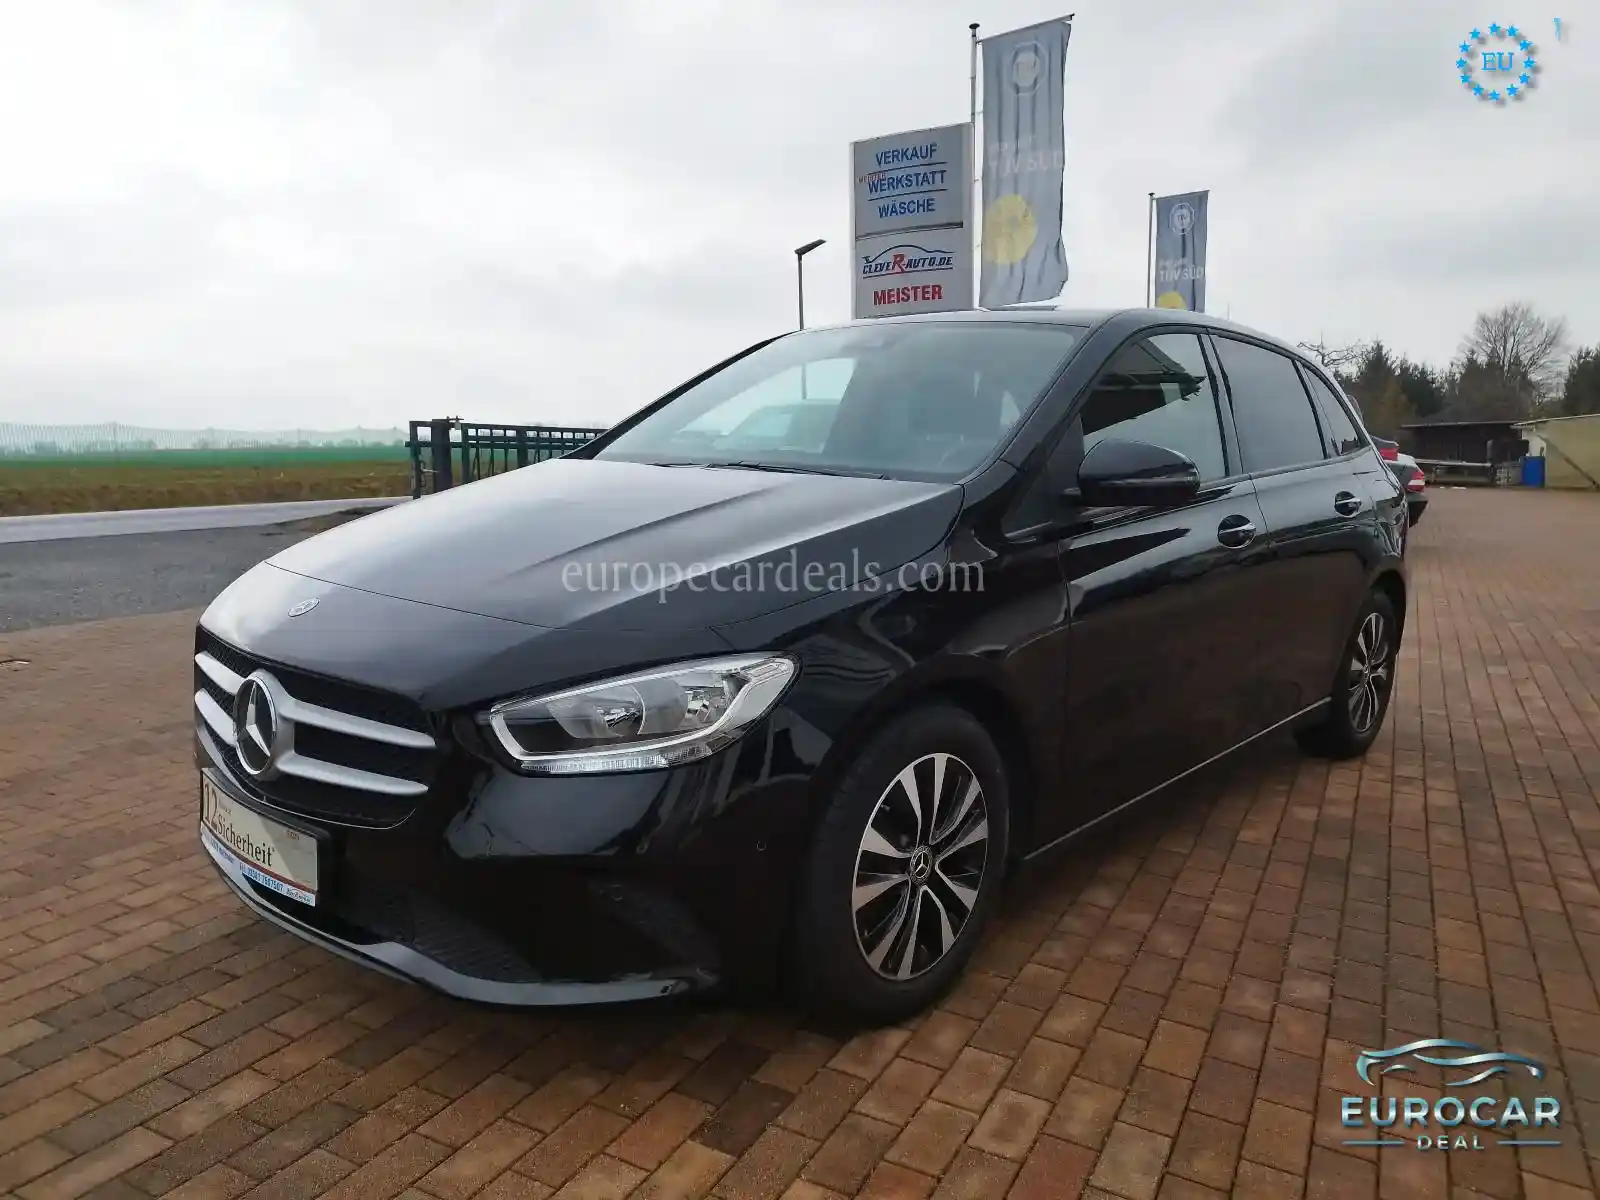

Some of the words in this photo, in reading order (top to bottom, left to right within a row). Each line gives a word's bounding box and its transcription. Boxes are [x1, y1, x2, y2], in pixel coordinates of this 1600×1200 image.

[876, 142, 937, 167] VERKAUF
[868, 170, 947, 194] WERKSTATT
[878, 198, 936, 219] WÄSCHE
[873, 284, 943, 305] MEISTER
